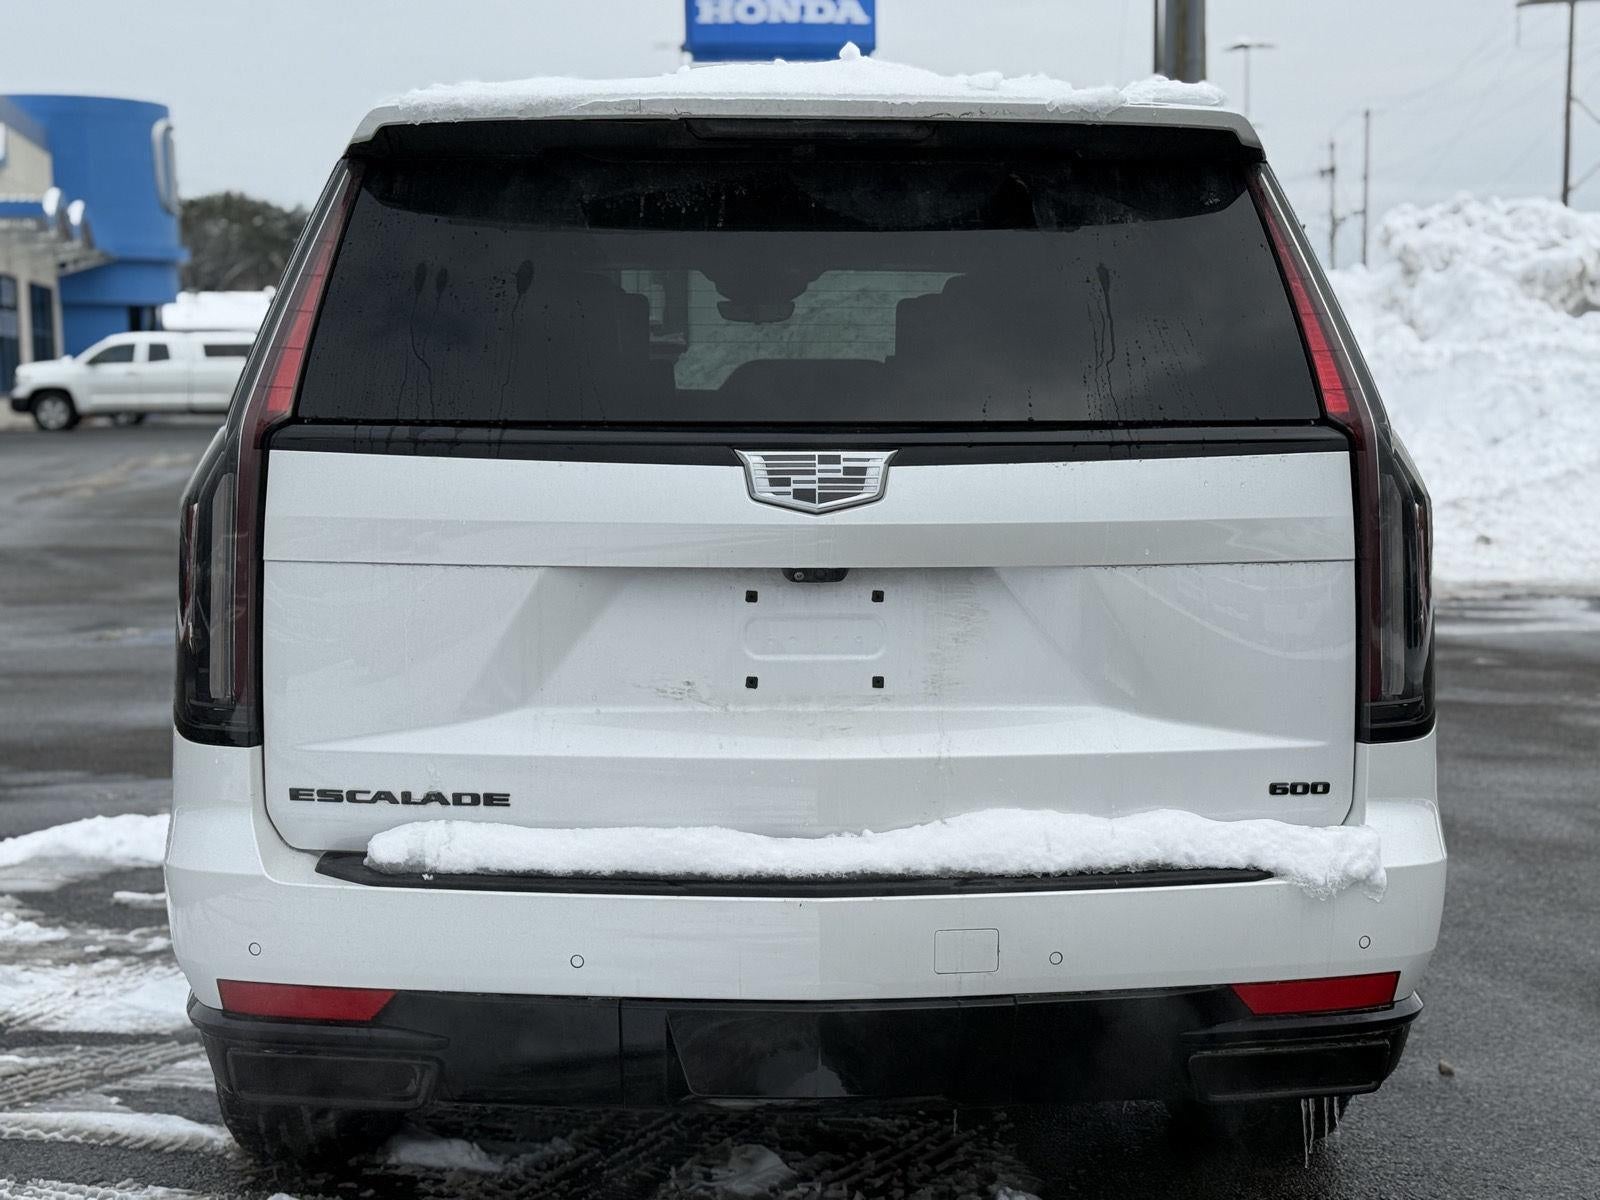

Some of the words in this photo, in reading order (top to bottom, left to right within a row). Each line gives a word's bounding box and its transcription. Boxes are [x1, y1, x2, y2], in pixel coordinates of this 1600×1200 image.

[696, 0, 870, 24] HONDA
[289, 787, 511, 807] ESCALADE
[1269, 782, 1330, 795] 600
